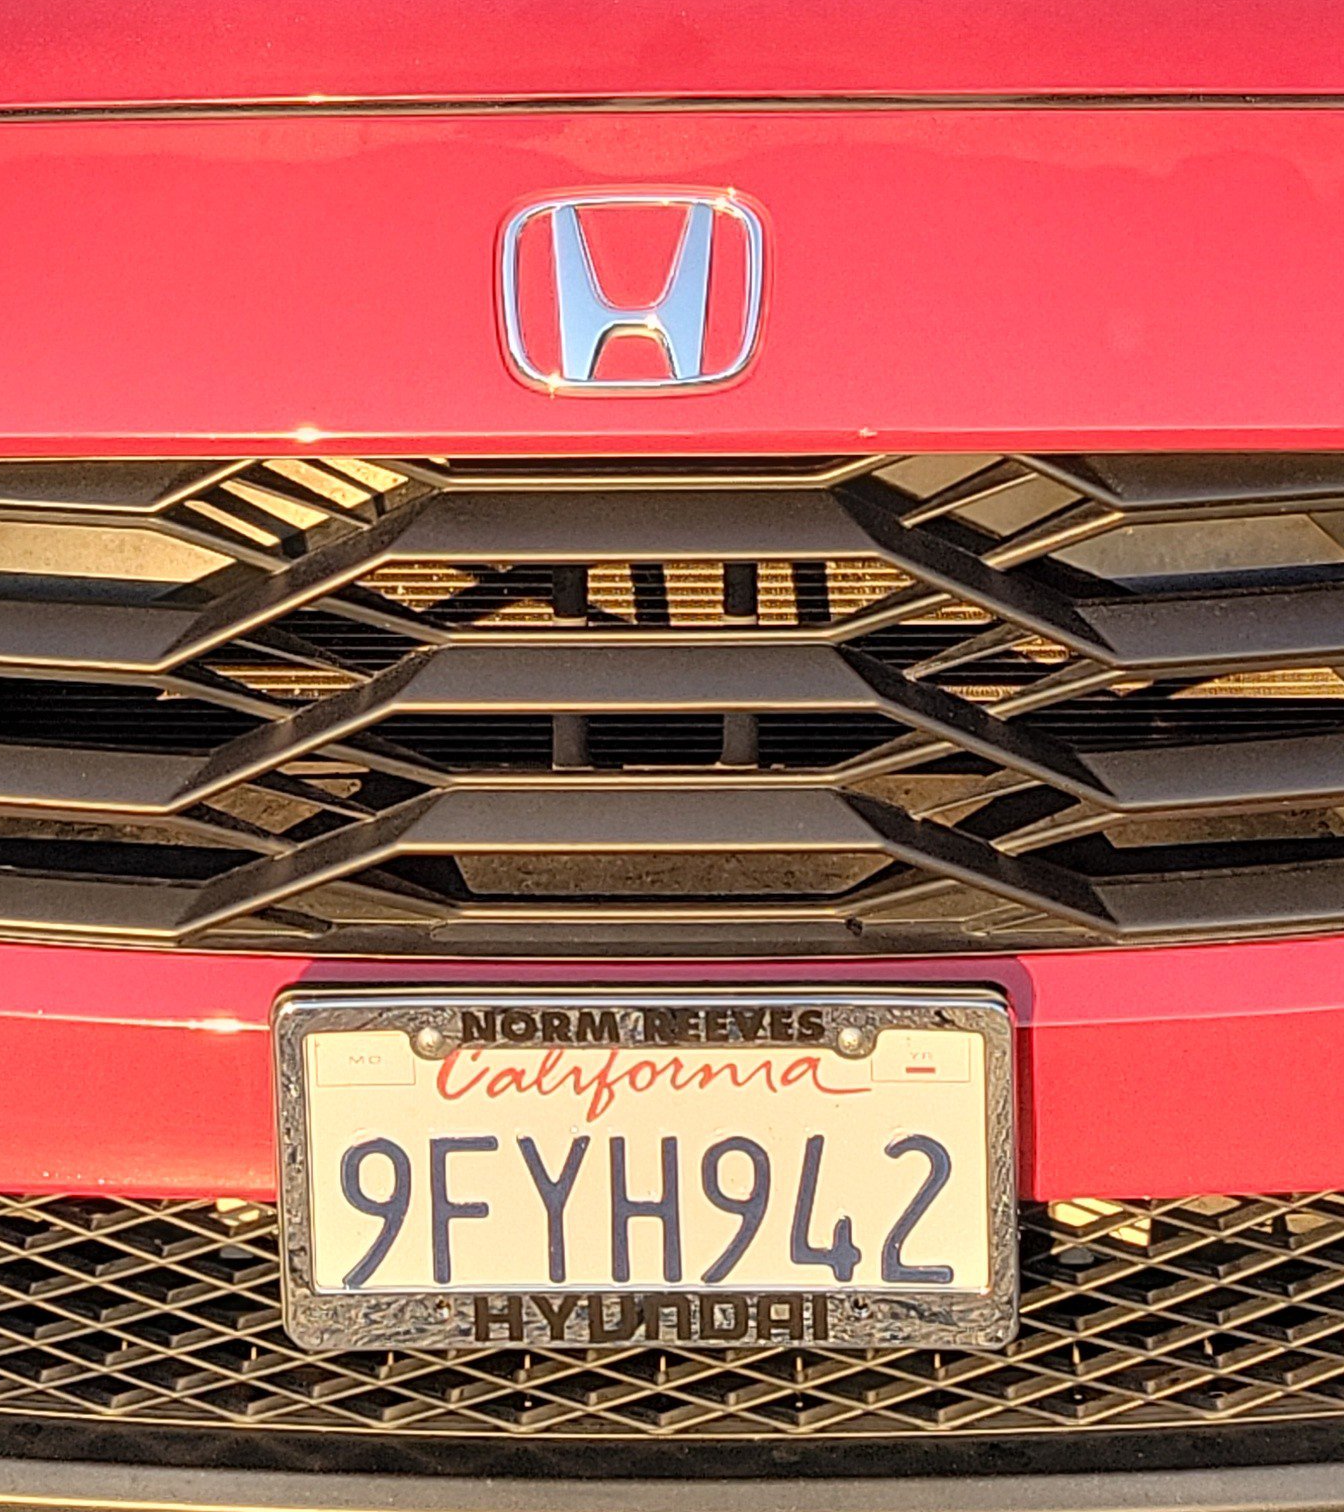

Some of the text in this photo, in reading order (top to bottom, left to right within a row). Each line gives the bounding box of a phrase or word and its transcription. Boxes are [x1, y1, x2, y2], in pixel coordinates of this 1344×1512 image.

[460, 1009, 826, 1042] NORM REEVES
[348, 1055, 382, 1066] MO
[436, 1046, 872, 1123] California
[340, 1134, 955, 1289] 9FYH942
[473, 1293, 830, 1343] HYUNDAI
